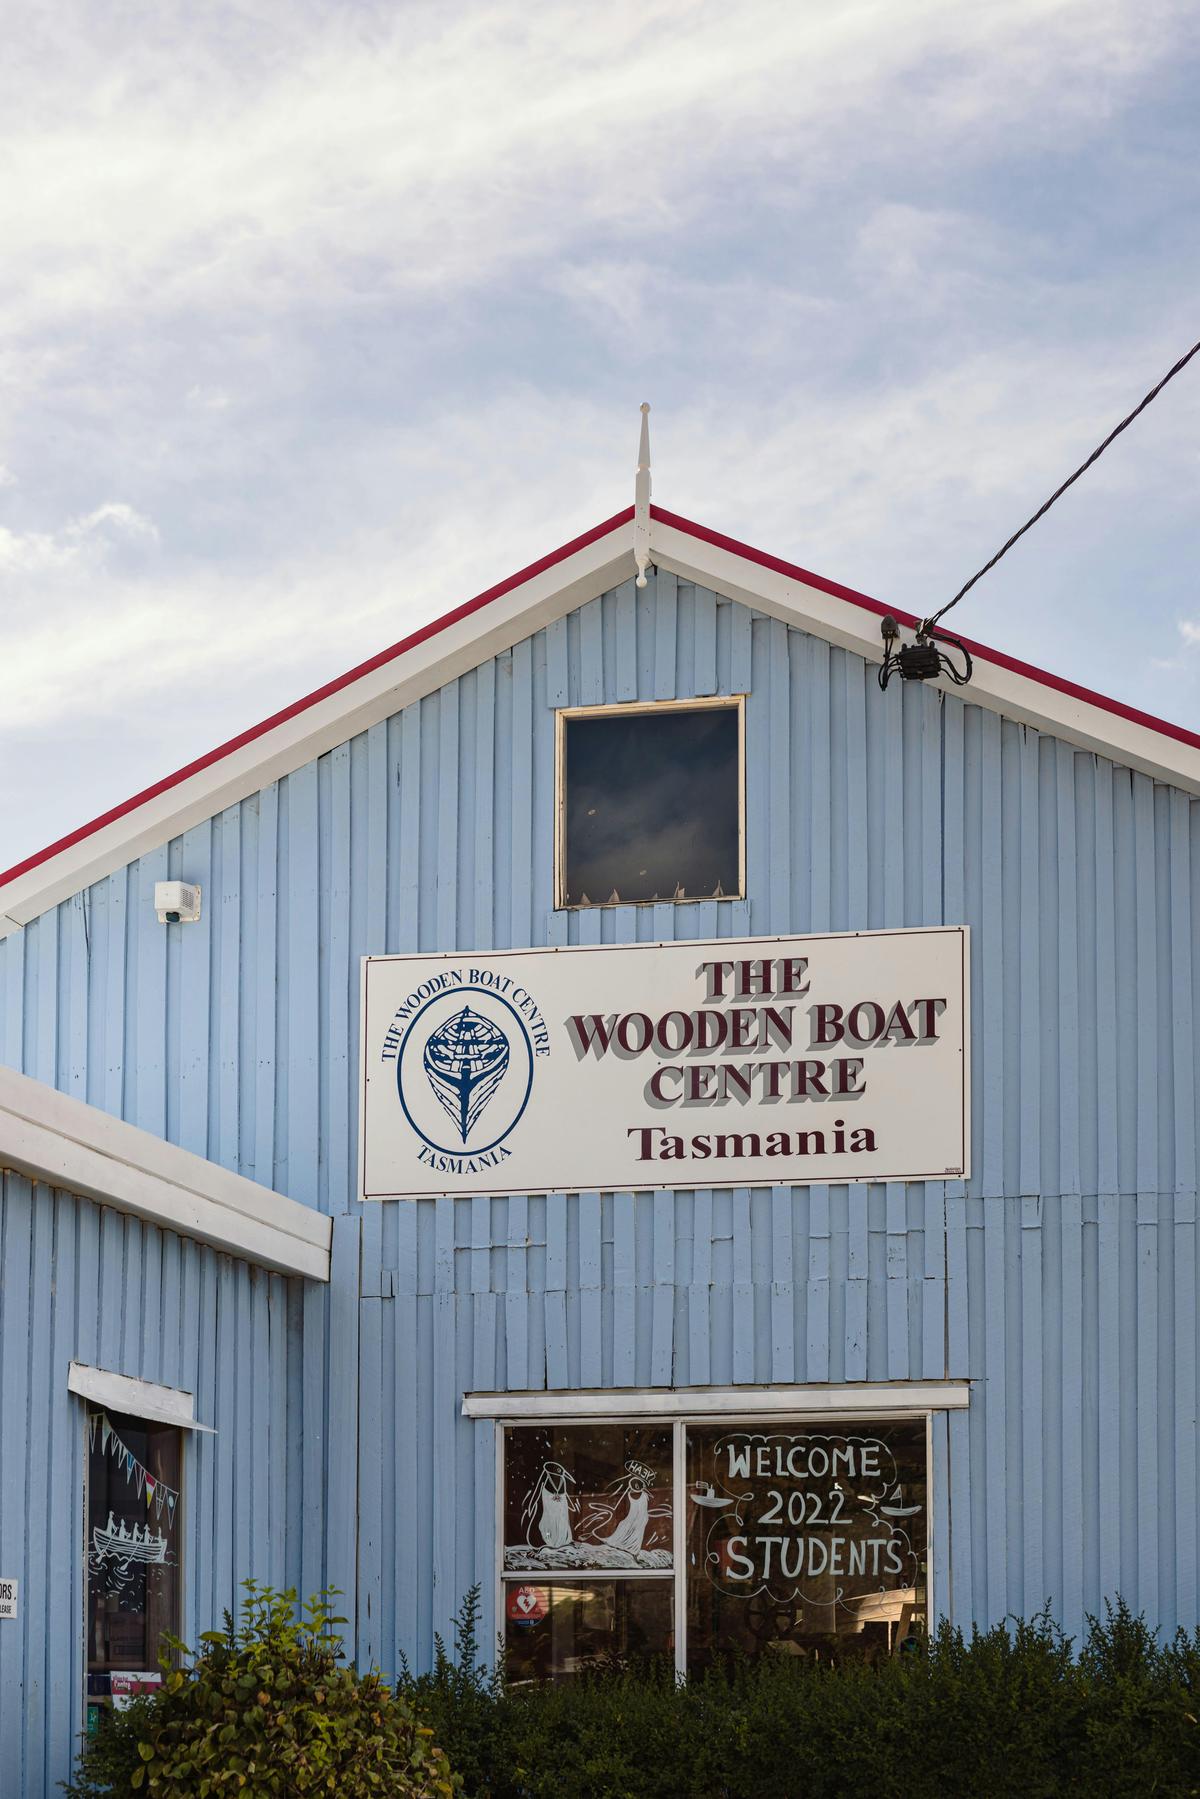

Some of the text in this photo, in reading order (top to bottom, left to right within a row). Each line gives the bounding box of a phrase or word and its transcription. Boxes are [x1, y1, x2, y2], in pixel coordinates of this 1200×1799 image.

[695, 957, 811, 1004] THE
[381, 968, 550, 1062] THE WOODEN BOAT CENTRE
[563, 998, 947, 1062] WOODEN BOAT
[643, 1057, 867, 1110] CENTRE
[417, 1145, 512, 1174] TASMANIA
[627, 1119, 879, 1161] Tasmania
[727, 1444, 881, 1479] WELCOME
[757, 1490, 853, 1526] 2022
[726, 1536, 903, 1580] STUDENTS
